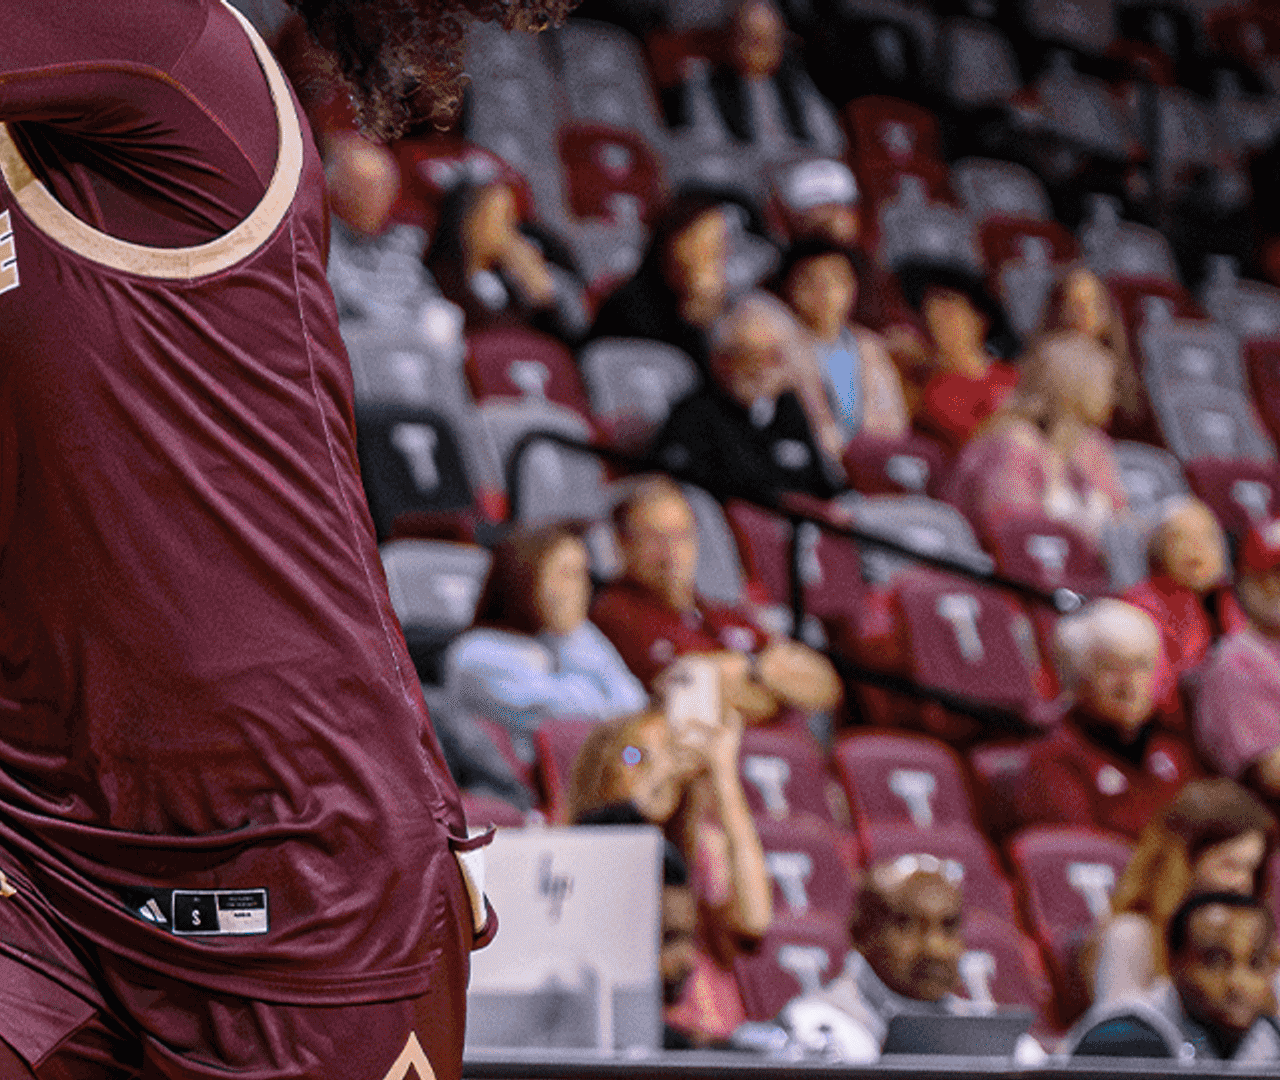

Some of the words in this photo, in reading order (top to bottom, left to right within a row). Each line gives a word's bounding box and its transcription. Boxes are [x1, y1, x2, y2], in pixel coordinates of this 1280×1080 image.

[390, 422, 437, 490] T
[937, 595, 985, 662] T
[745, 757, 790, 820] T
[890, 769, 935, 828] T
[767, 853, 811, 915] T
[1069, 863, 1116, 915] T
[191, 908, 202, 926] S
[778, 946, 829, 995] T
